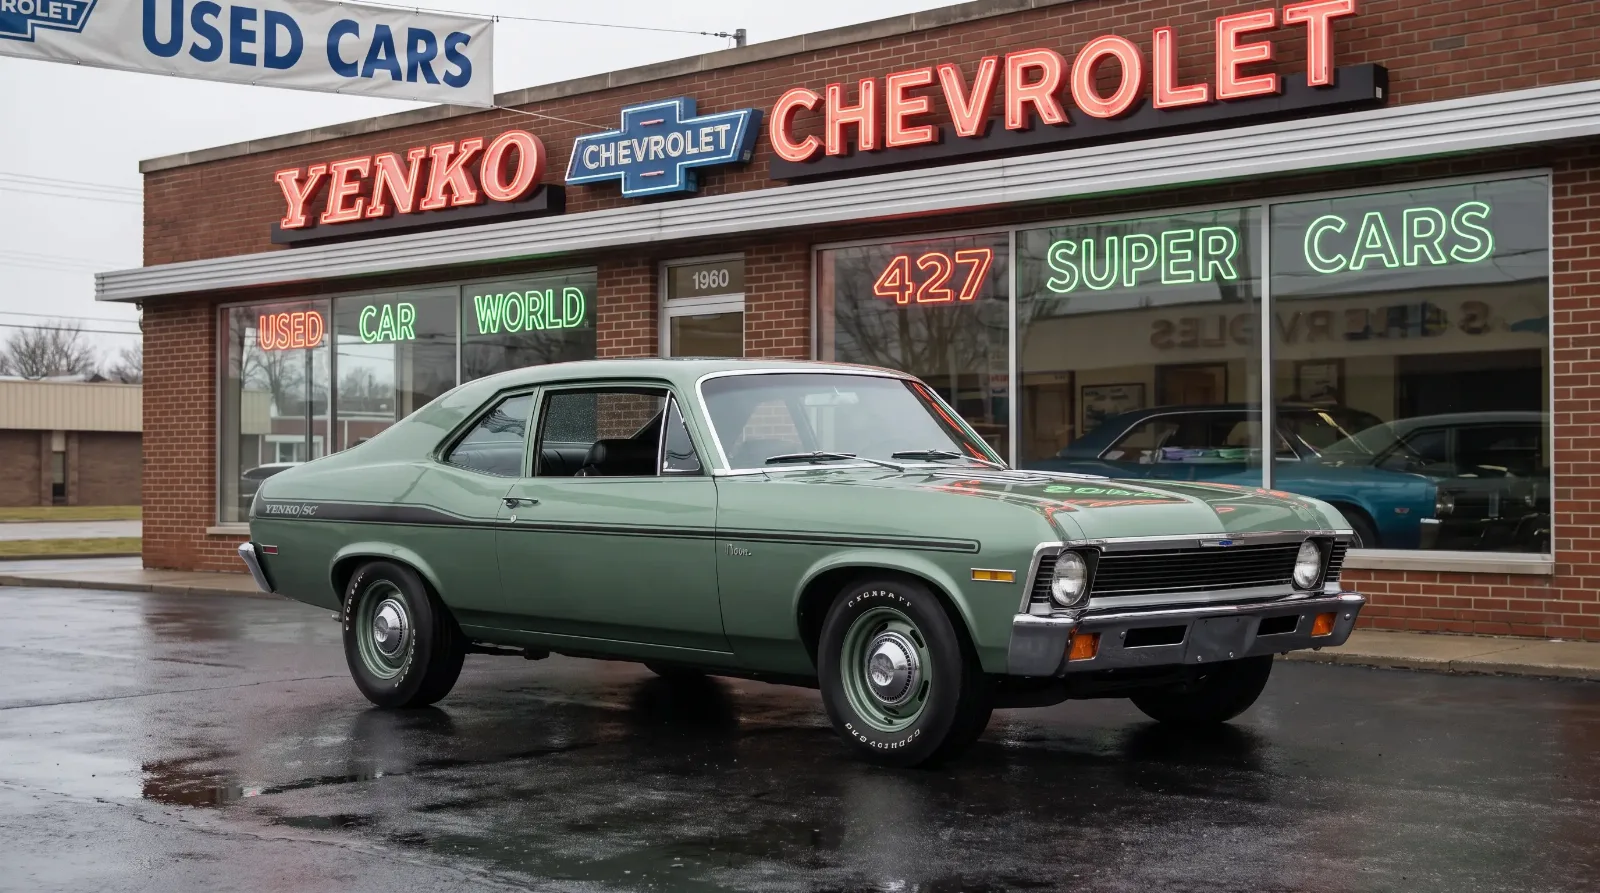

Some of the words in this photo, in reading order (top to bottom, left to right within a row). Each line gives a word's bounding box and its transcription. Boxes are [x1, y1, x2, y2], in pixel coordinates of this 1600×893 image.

[142, 0, 304, 70] USED
[326, 19, 473, 88] CARS
[769, 0, 1357, 163] CHEVROLET
[275, 129, 544, 230] YENKO
[583, 124, 731, 170] CHEVROLET
[692, 269, 730, 290] 1960
[873, 248, 993, 304] 427
[1046, 226, 1239, 293] SUPER
[1303, 202, 1497, 274] CARS
[259, 311, 324, 350] USED
[358, 302, 416, 344] CAR
[473, 287, 586, 335] WORLD
[265, 503, 319, 518] YENKO/SC
